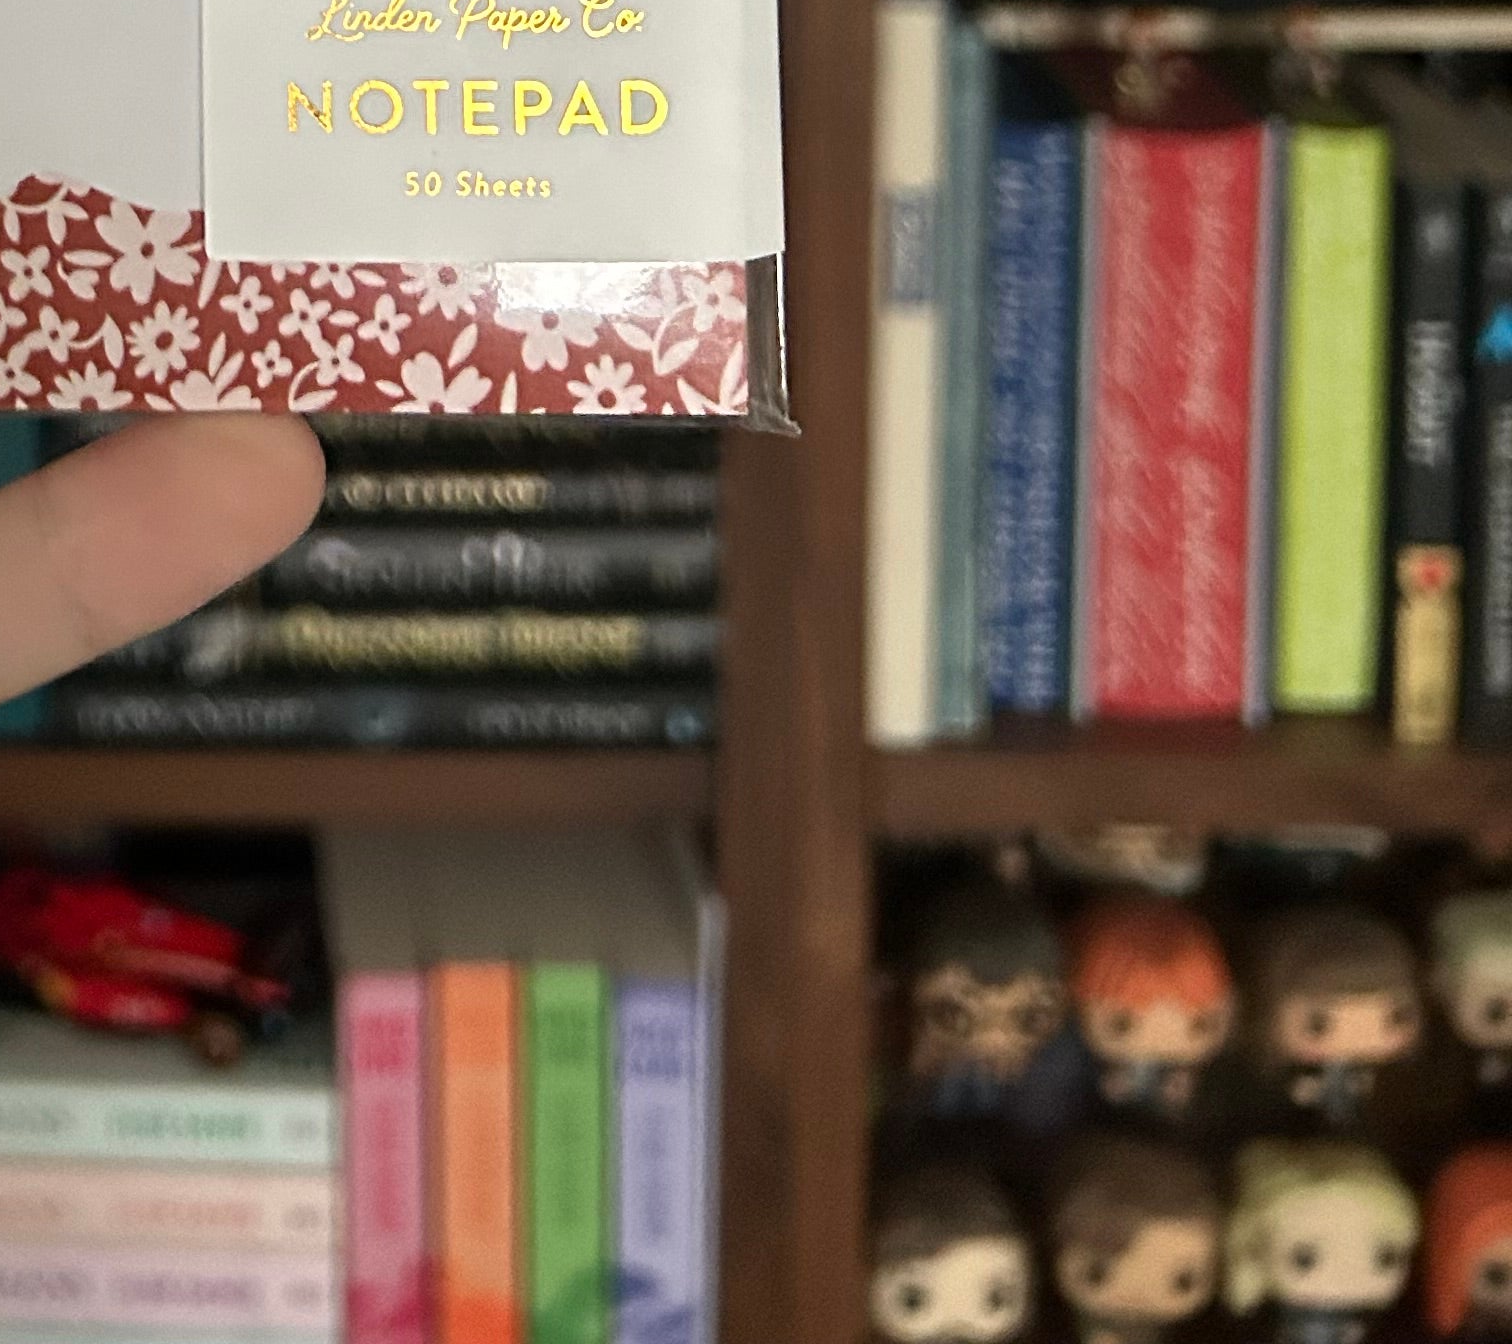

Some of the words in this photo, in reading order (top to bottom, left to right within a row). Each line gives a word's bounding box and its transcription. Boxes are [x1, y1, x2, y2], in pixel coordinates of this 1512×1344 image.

[287, 78, 670, 136] NOTEPAD
[404, 170, 442, 198] 50
[456, 171, 553, 199] Sheets
